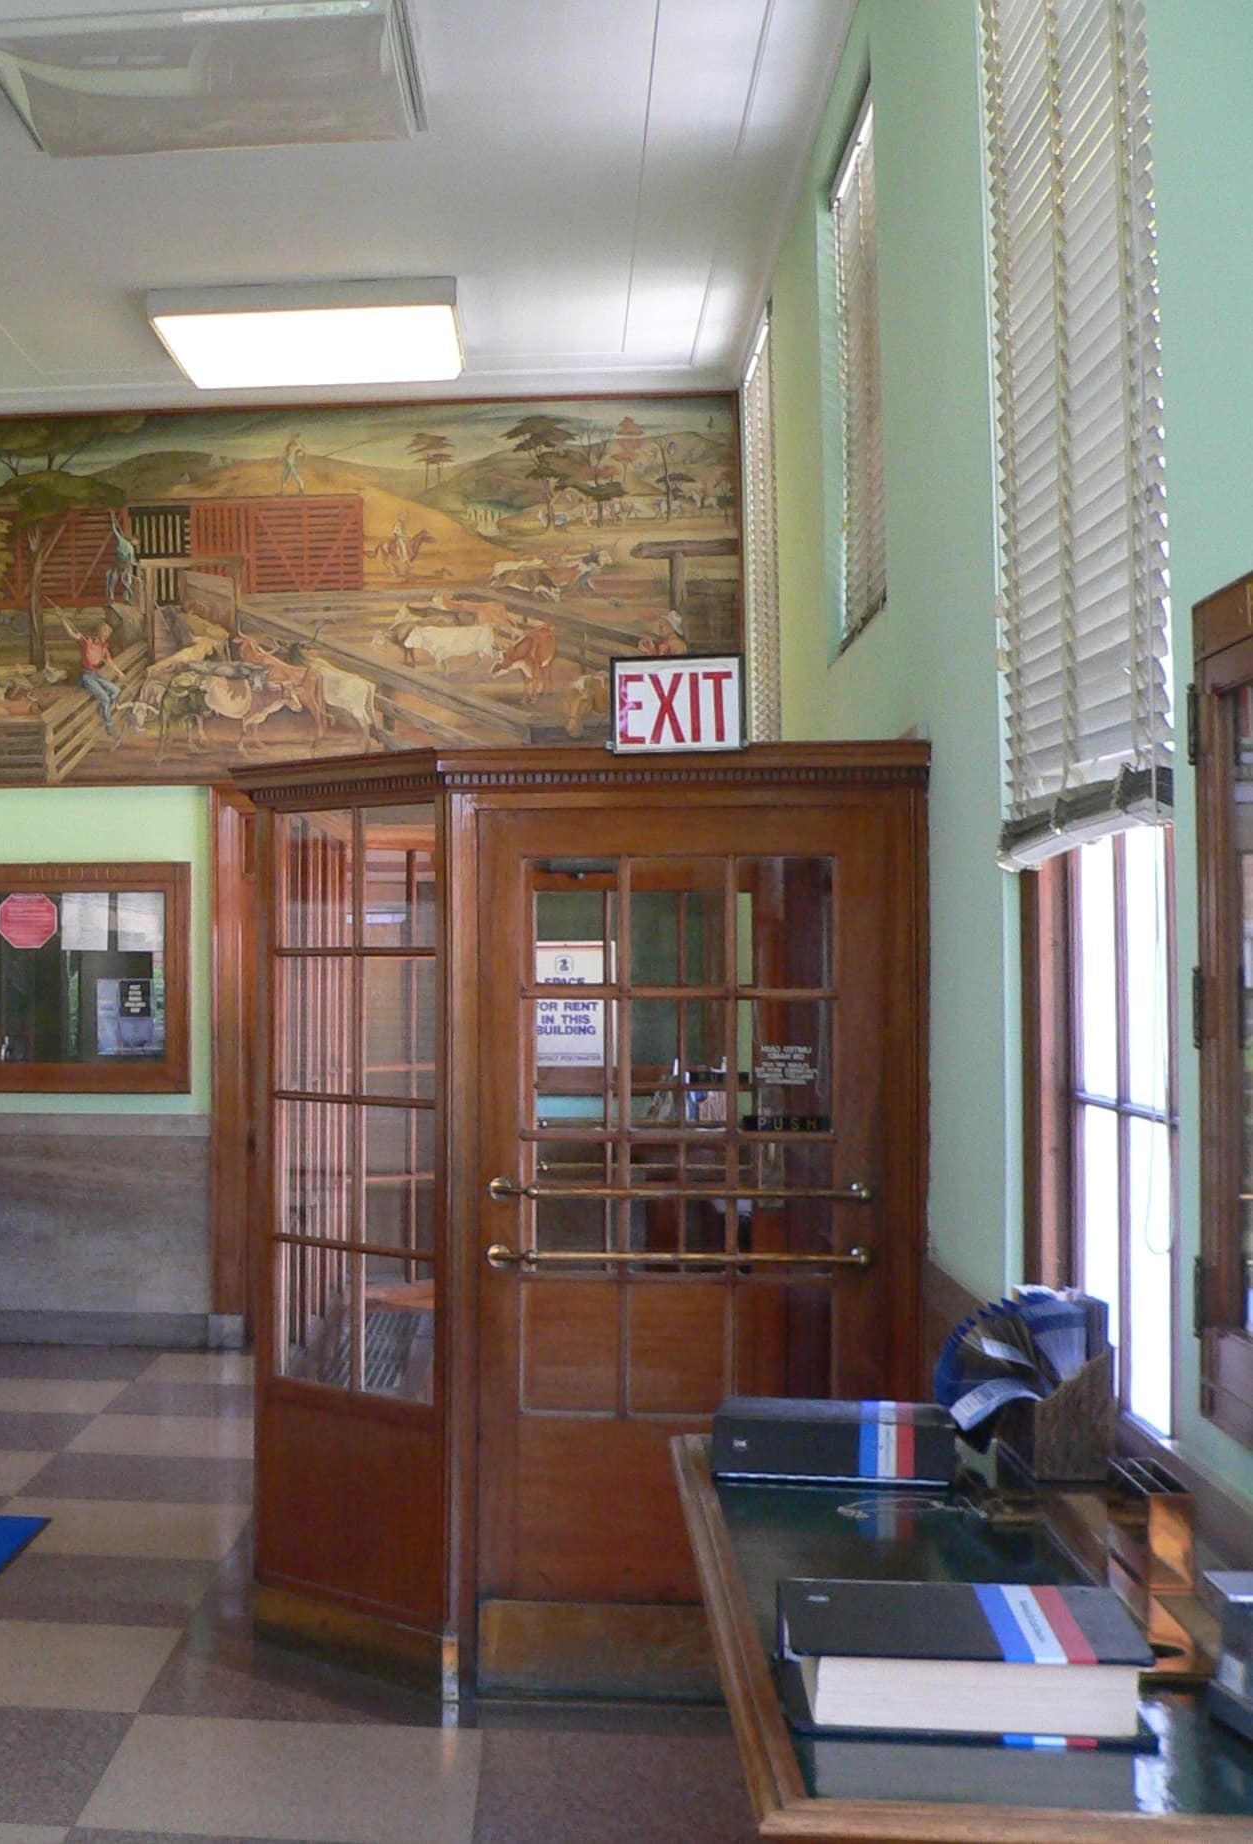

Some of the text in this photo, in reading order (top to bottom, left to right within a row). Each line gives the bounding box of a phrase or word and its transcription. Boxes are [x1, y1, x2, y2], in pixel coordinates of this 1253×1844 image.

[619, 671, 733, 745] EXIT
[564, 1001, 599, 1012] RENT
[541, 1014, 591, 1025] IN THIS
[536, 1025, 596, 1036] BUILDING
[757, 1117, 818, 1131] PUSH
